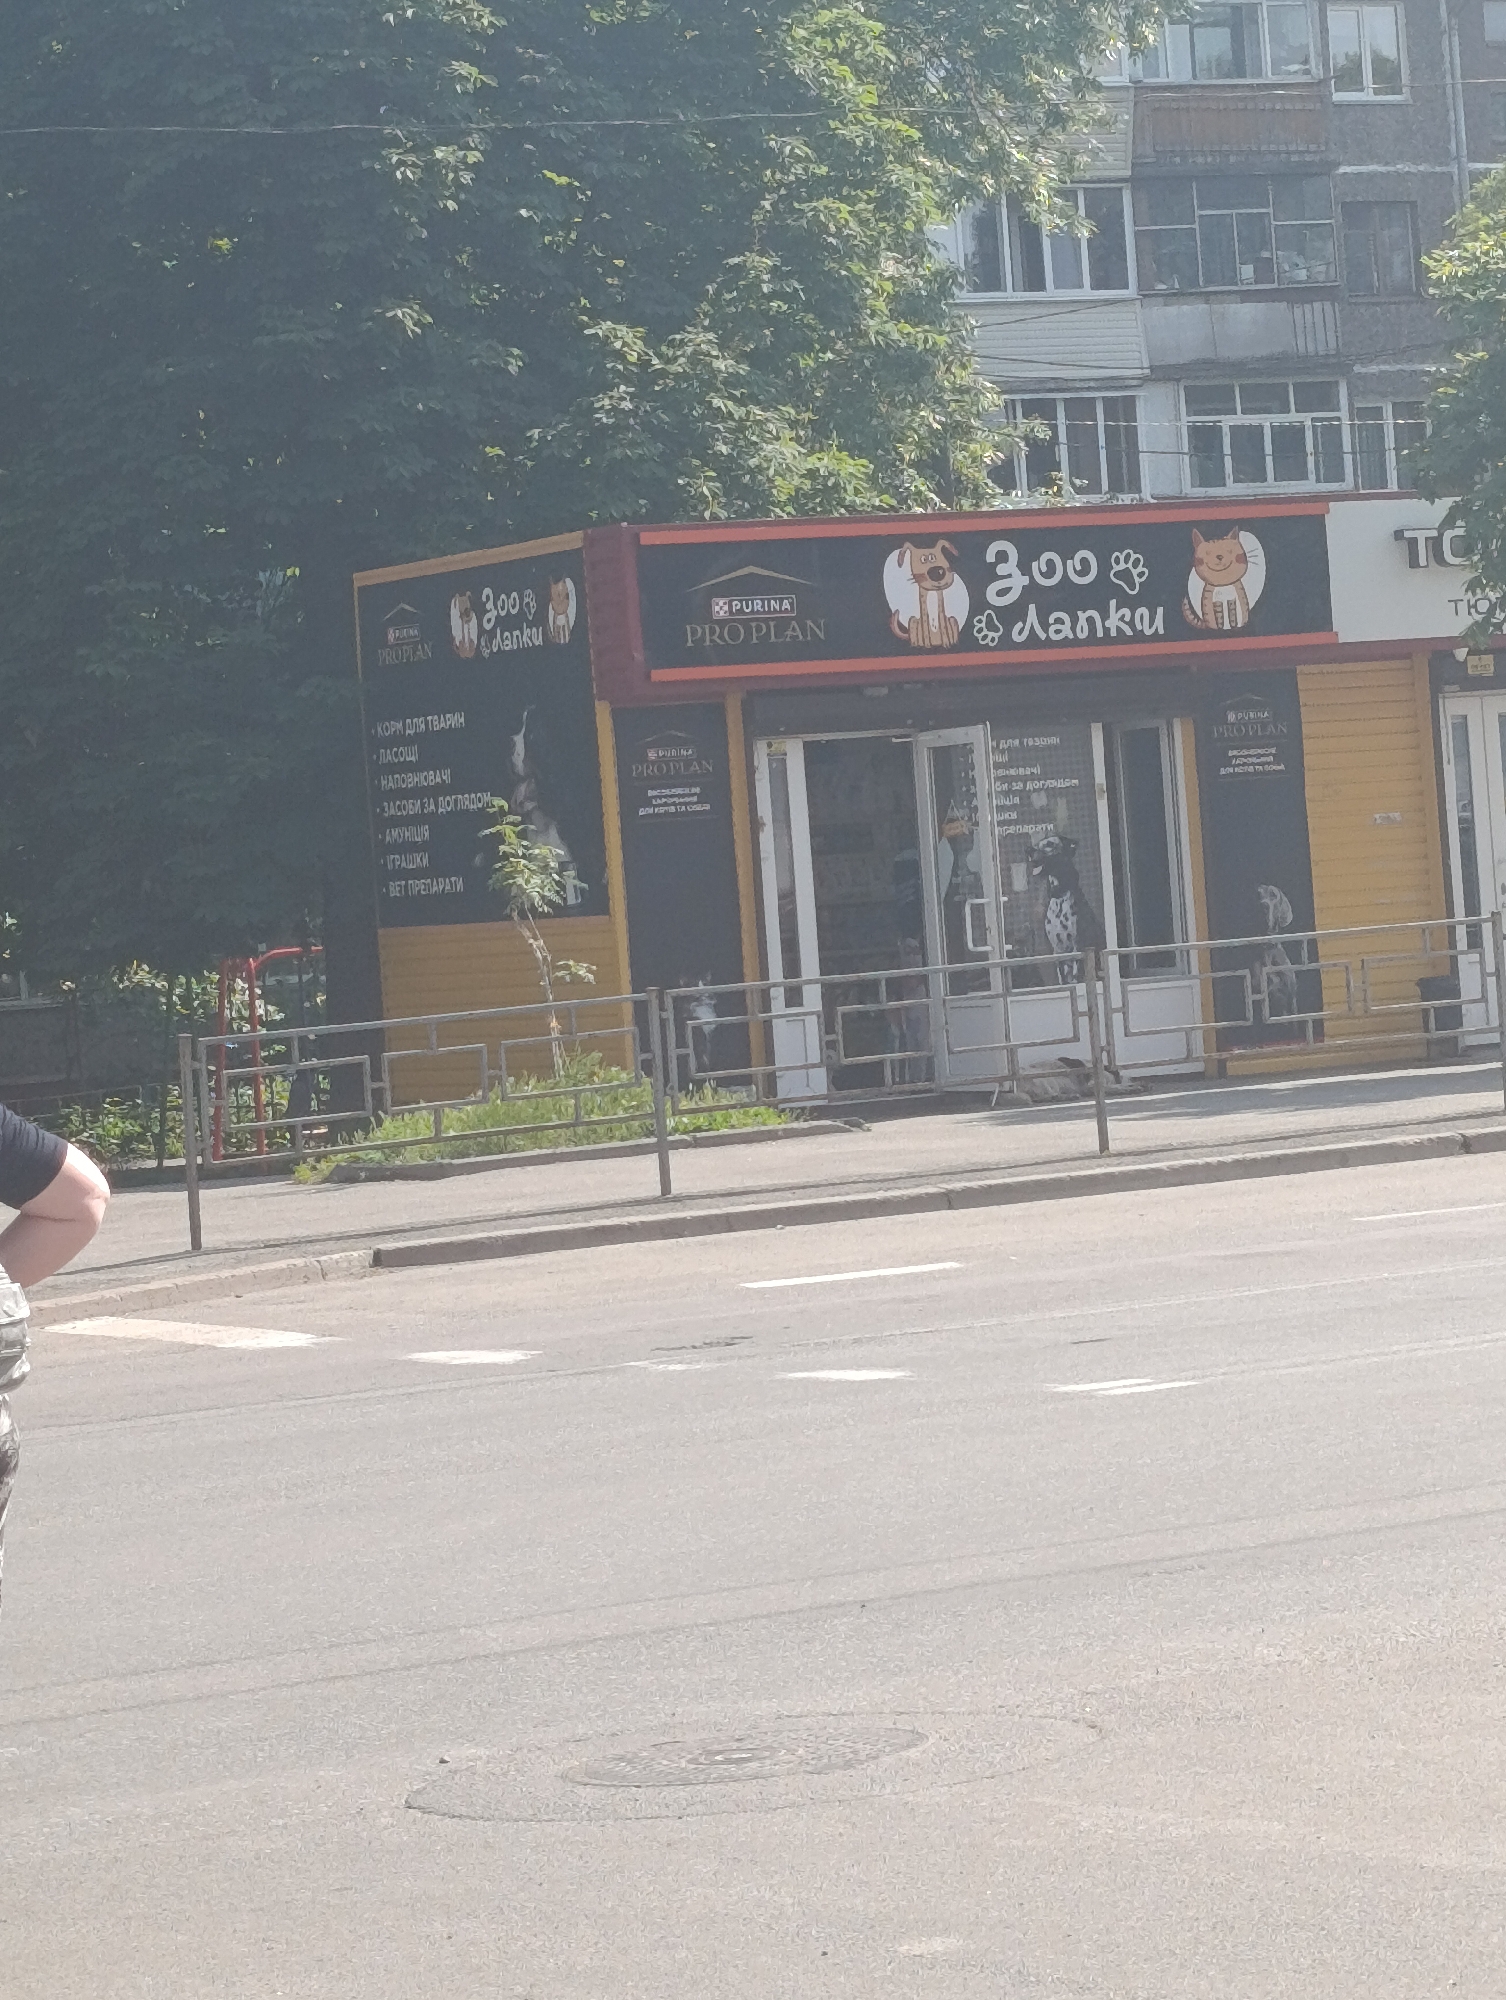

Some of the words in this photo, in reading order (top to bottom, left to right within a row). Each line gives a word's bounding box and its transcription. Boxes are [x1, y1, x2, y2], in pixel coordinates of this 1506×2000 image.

[986, 540, 1098, 606] Зоо
[482, 587, 519, 630] Зоо
[732, 599, 791, 613] PURINA
[1011, 599, 1164, 643] Лапки
[492, 621, 543, 652] Лапки
[376, 720, 404, 738] КОРМ
[405, 717, 426, 736] ДЛЯ
[427, 711, 465, 731] ТВАРИН
[379, 744, 419, 765] ЛАСОЩІ
[381, 767, 451, 791] НАПОВНЮВАЧІ
[383, 799, 422, 817] ЗАСОБИ
[423, 797, 436, 814] ЗА
[438, 792, 492, 814] ДОГЛЯДОМ
[386, 824, 430, 844] АМУНІЦІЯ
[386, 852, 429, 870] ІГРАШКИ
[389, 881, 406, 897] ВЕТ
[408, 877, 464, 896] ПРЕПАРАТИ
